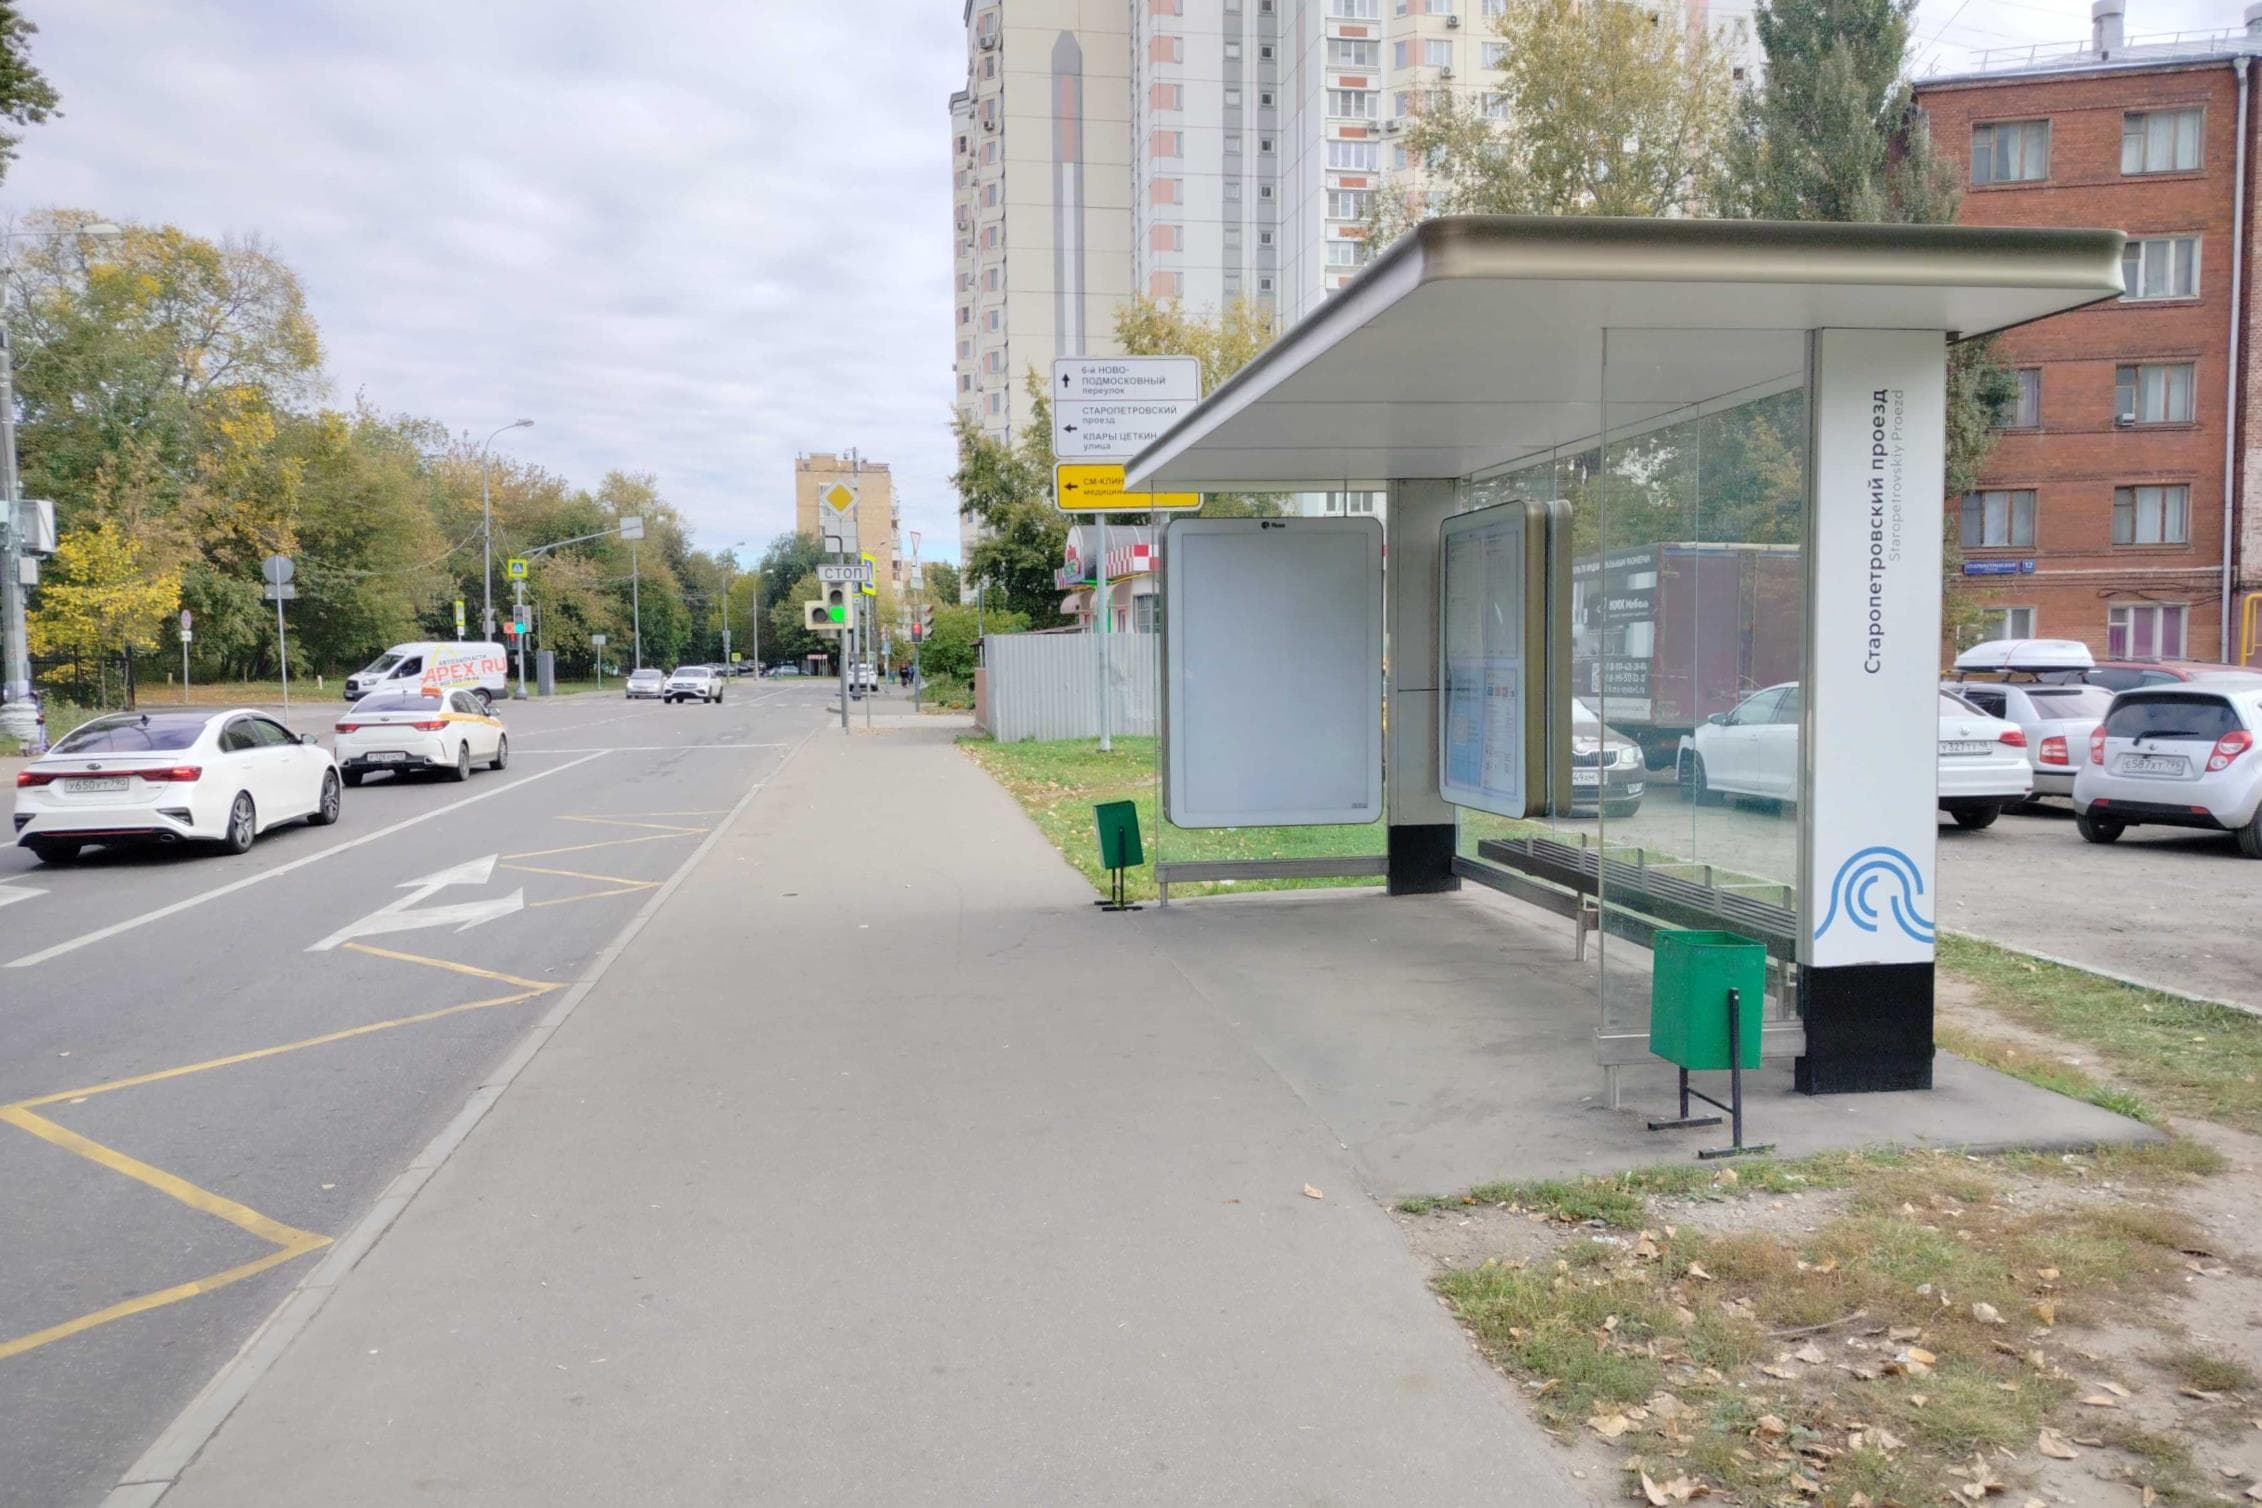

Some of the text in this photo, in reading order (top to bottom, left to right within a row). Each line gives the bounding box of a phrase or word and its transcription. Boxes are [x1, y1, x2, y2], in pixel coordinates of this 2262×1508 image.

[1098, 366, 1130, 374] НОВО-
[1082, 376, 1166, 385] ПОДМОСКОВНЫЙ
[1082, 387, 1125, 396] переулок
[1082, 405, 1177, 415] СТАРОПЕТРОВСКИЙ
[1082, 417, 1116, 425] проезд
[1083, 432, 1157, 442] КЛАРЫ ЦЕТКИН
[1083, 443, 1111, 451] улица
[1889, 389, 1904, 561] Staropetrovskiy Proezd
[1083, 478, 1124, 486] СМ-КЛИН
[1864, 389, 1888, 674] Старопетровский проезд
[824, 567, 863, 579] СТОП
[421, 662, 476, 683] APEX
